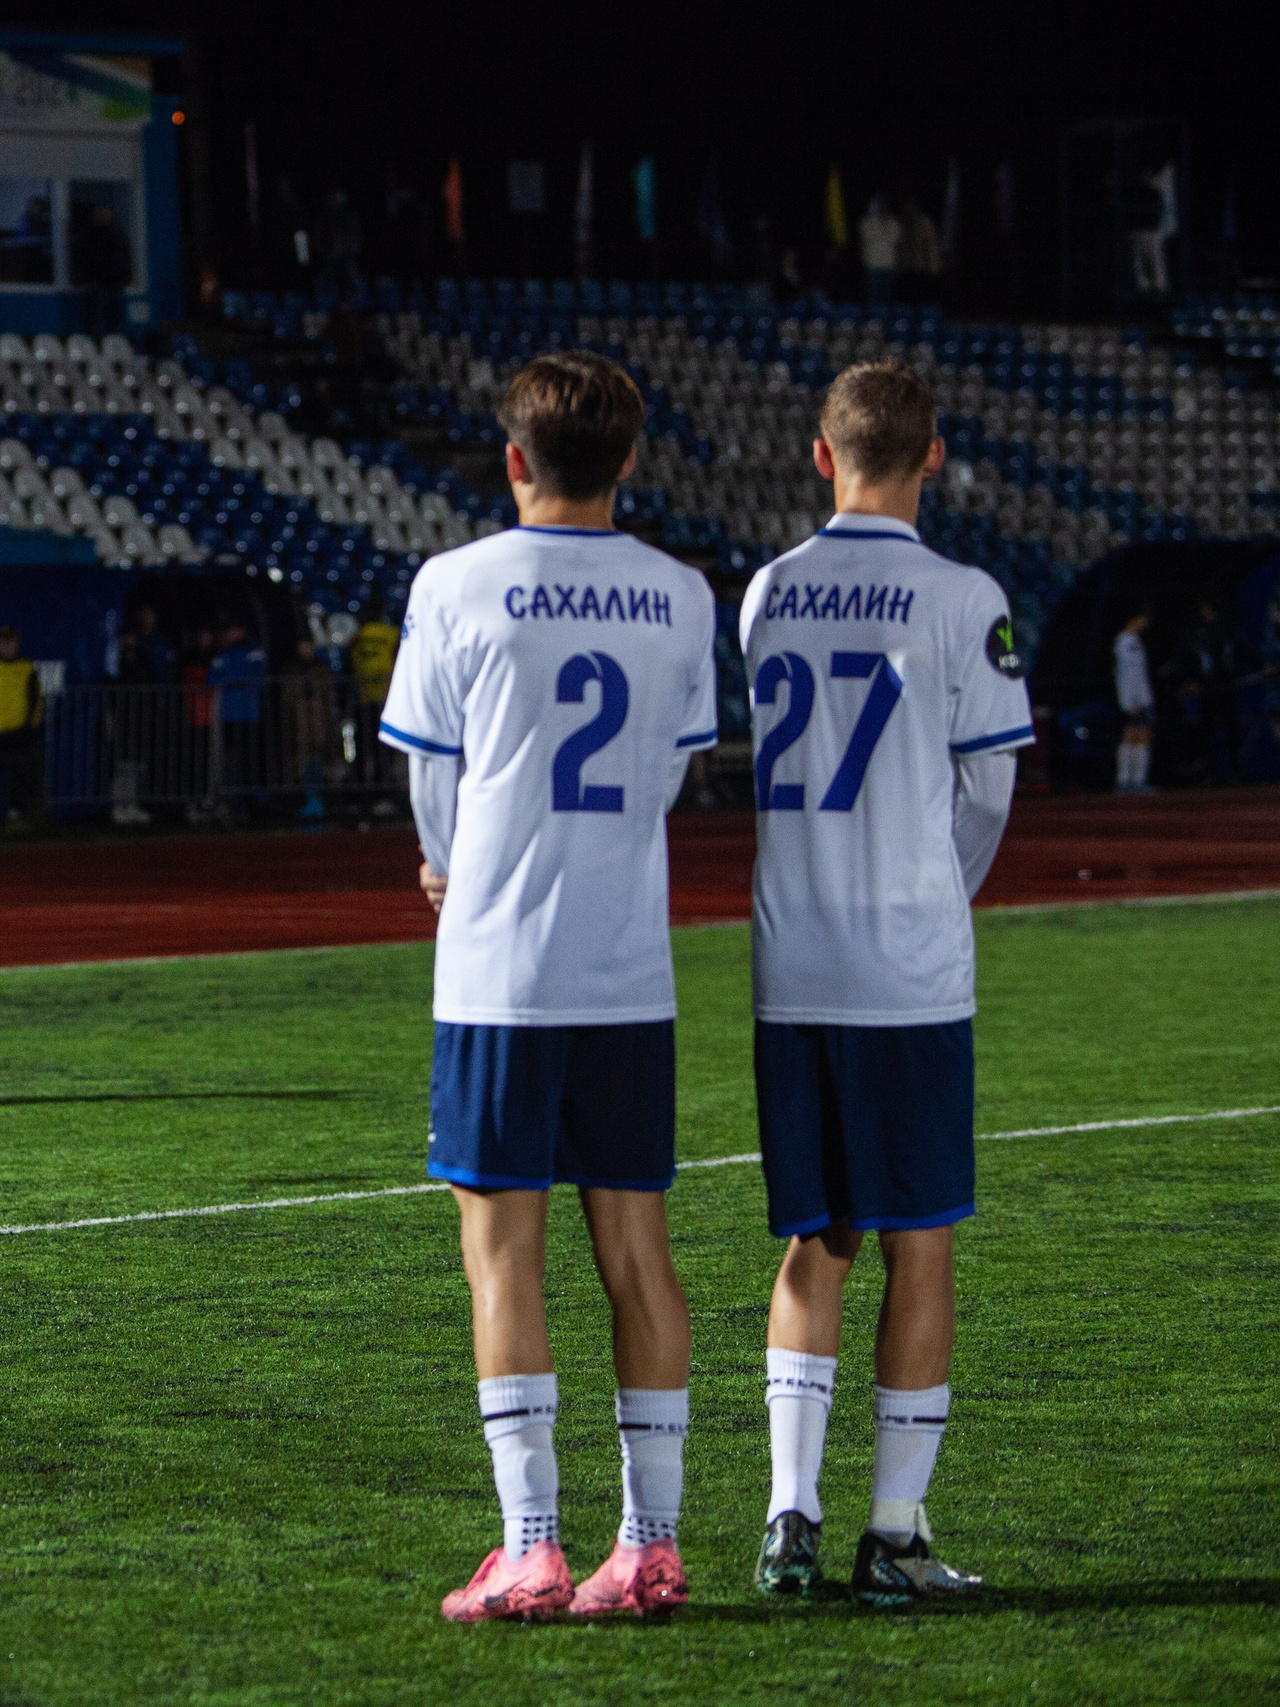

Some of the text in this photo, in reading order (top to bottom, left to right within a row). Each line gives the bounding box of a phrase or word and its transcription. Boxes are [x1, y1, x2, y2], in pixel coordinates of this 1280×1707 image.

[505, 583, 672, 628] САХАЛИН
[765, 583, 914, 625] САХАЛИН
[551, 650, 629, 813] 2
[754, 651, 903, 812] 27
